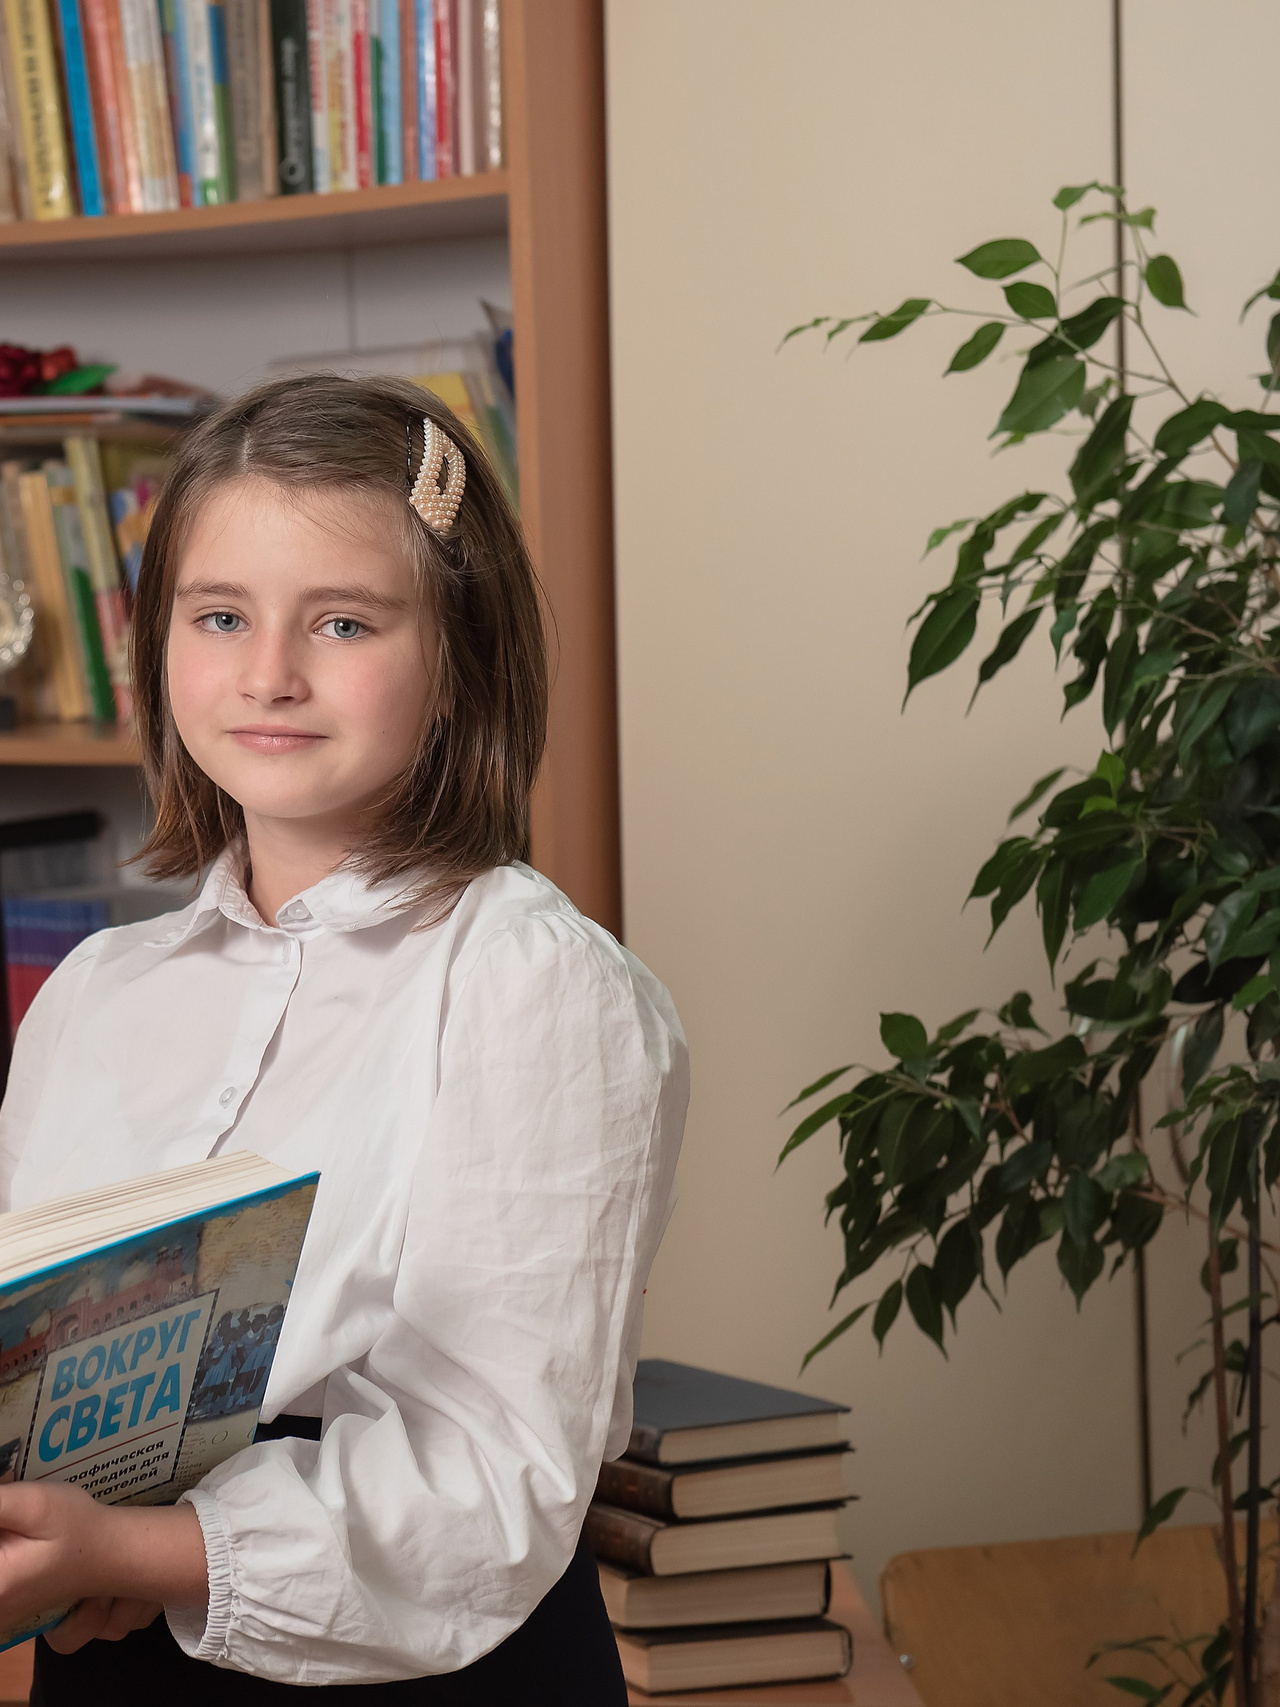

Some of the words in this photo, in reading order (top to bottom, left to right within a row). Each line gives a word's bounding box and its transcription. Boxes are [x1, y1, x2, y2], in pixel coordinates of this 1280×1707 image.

[50, 1309, 202, 1403] ВОКРУГ
[37, 1361, 182, 1464] СВЕТА
[140, 1451, 170, 1469] для
